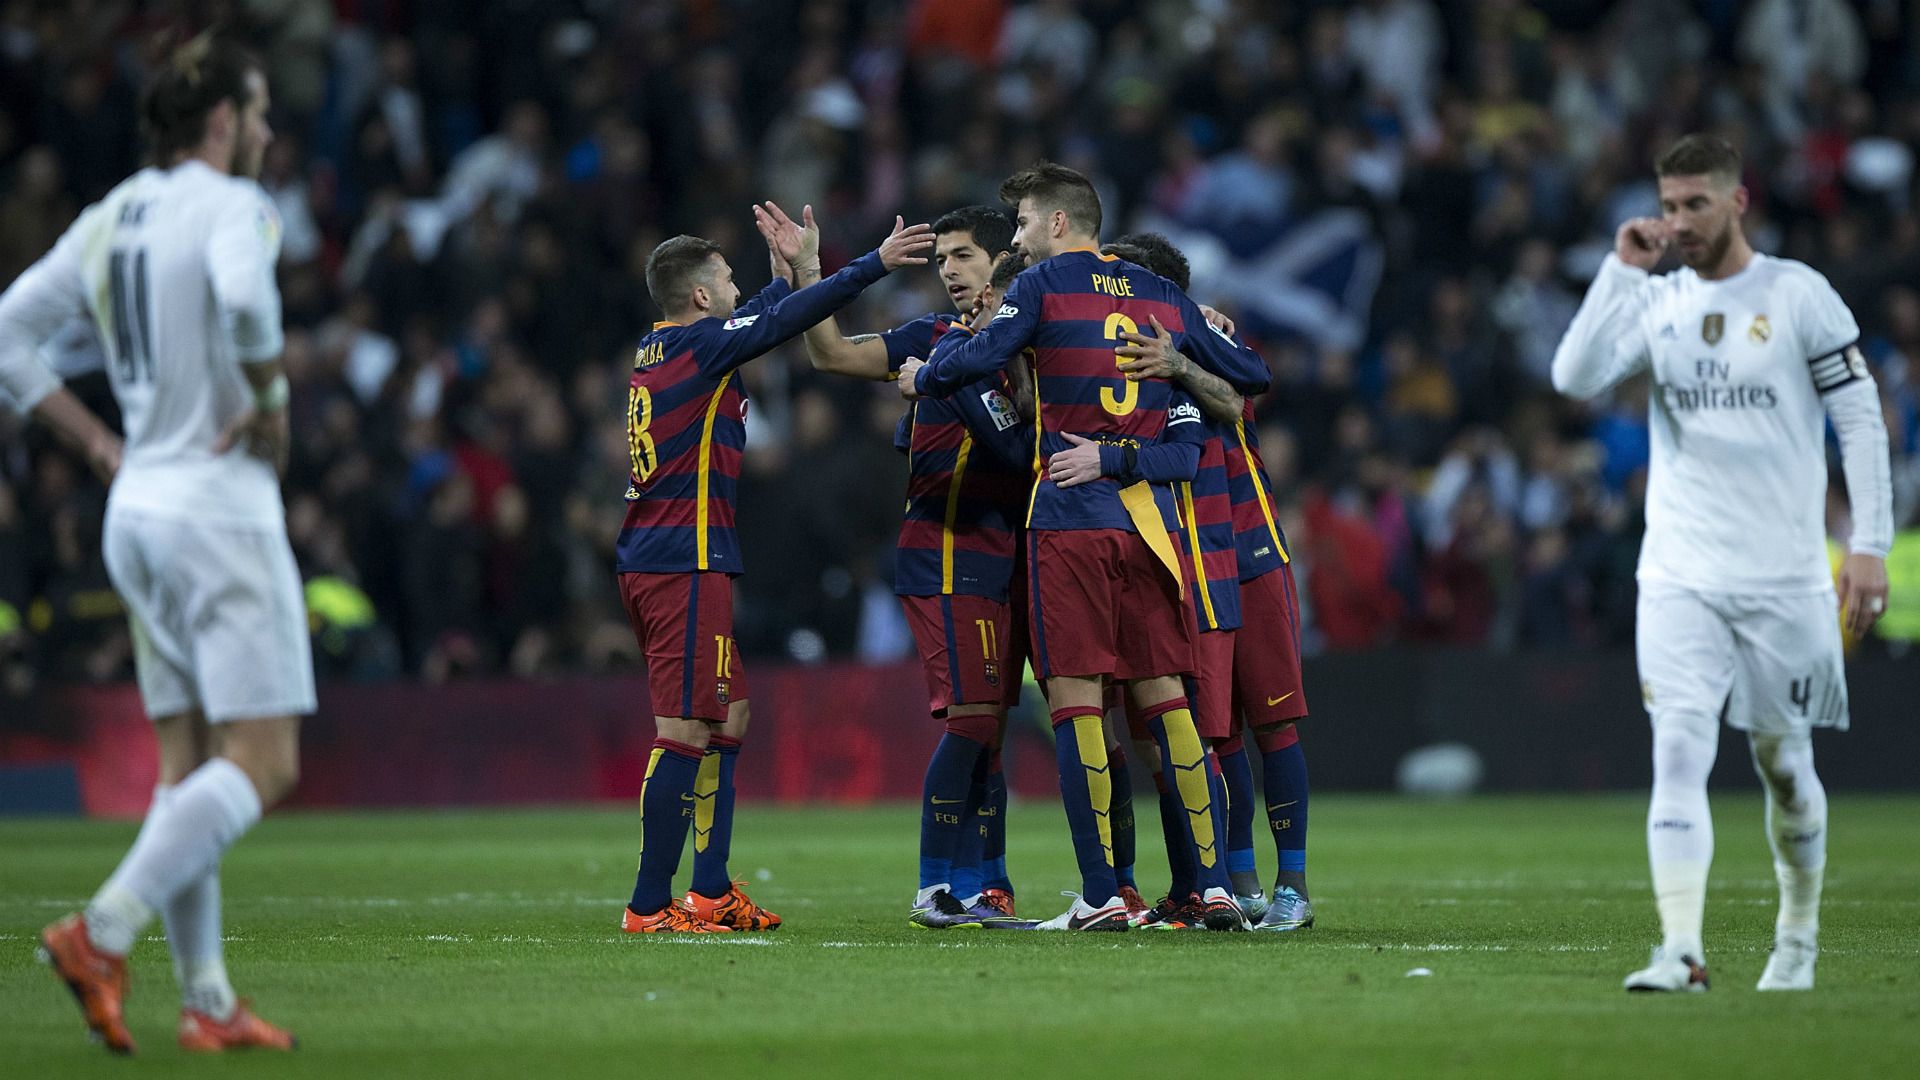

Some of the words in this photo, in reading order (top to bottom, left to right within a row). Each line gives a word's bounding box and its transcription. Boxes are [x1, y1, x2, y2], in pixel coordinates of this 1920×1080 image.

[1100, 312, 1139, 416] 3
[997, 411, 1018, 428] LFP
[1168, 402, 1201, 419] beko
[975, 619, 999, 661] 11
[1790, 675, 1812, 717] 4
[935, 812, 958, 824] FCB
